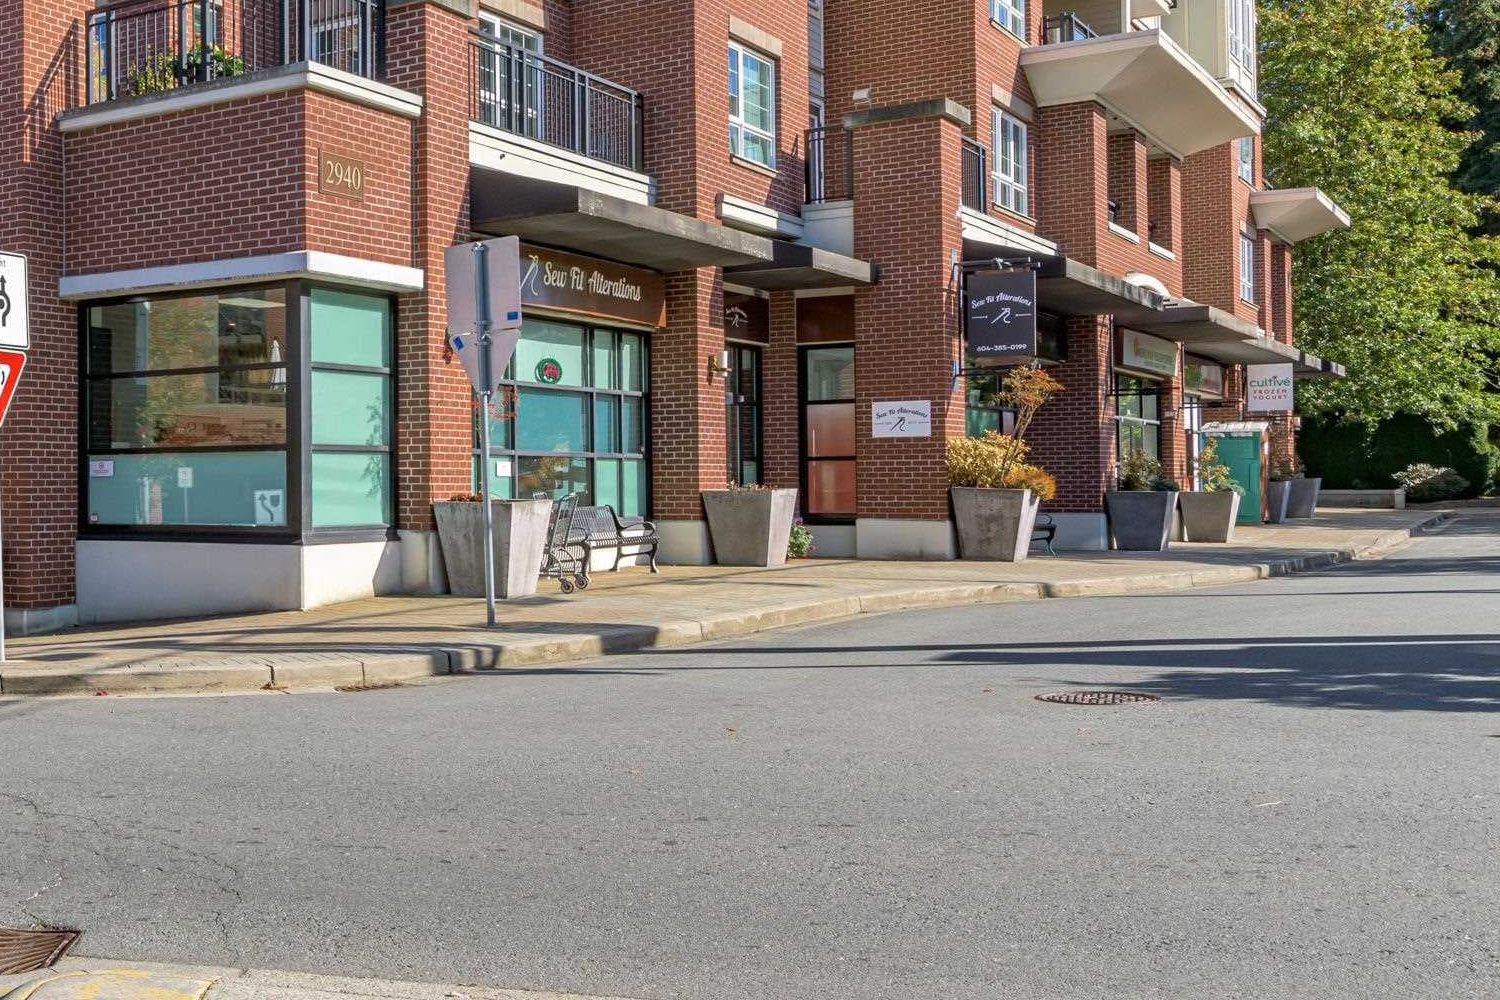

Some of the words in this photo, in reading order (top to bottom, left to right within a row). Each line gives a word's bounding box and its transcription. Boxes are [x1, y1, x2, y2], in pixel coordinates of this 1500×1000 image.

[326, 161, 360, 190] 2940
[543, 262, 567, 288] Sew
[570, 266, 583, 291] Fit
[587, 270, 641, 301] Alterations
[996, 292, 1032, 306] Alterations
